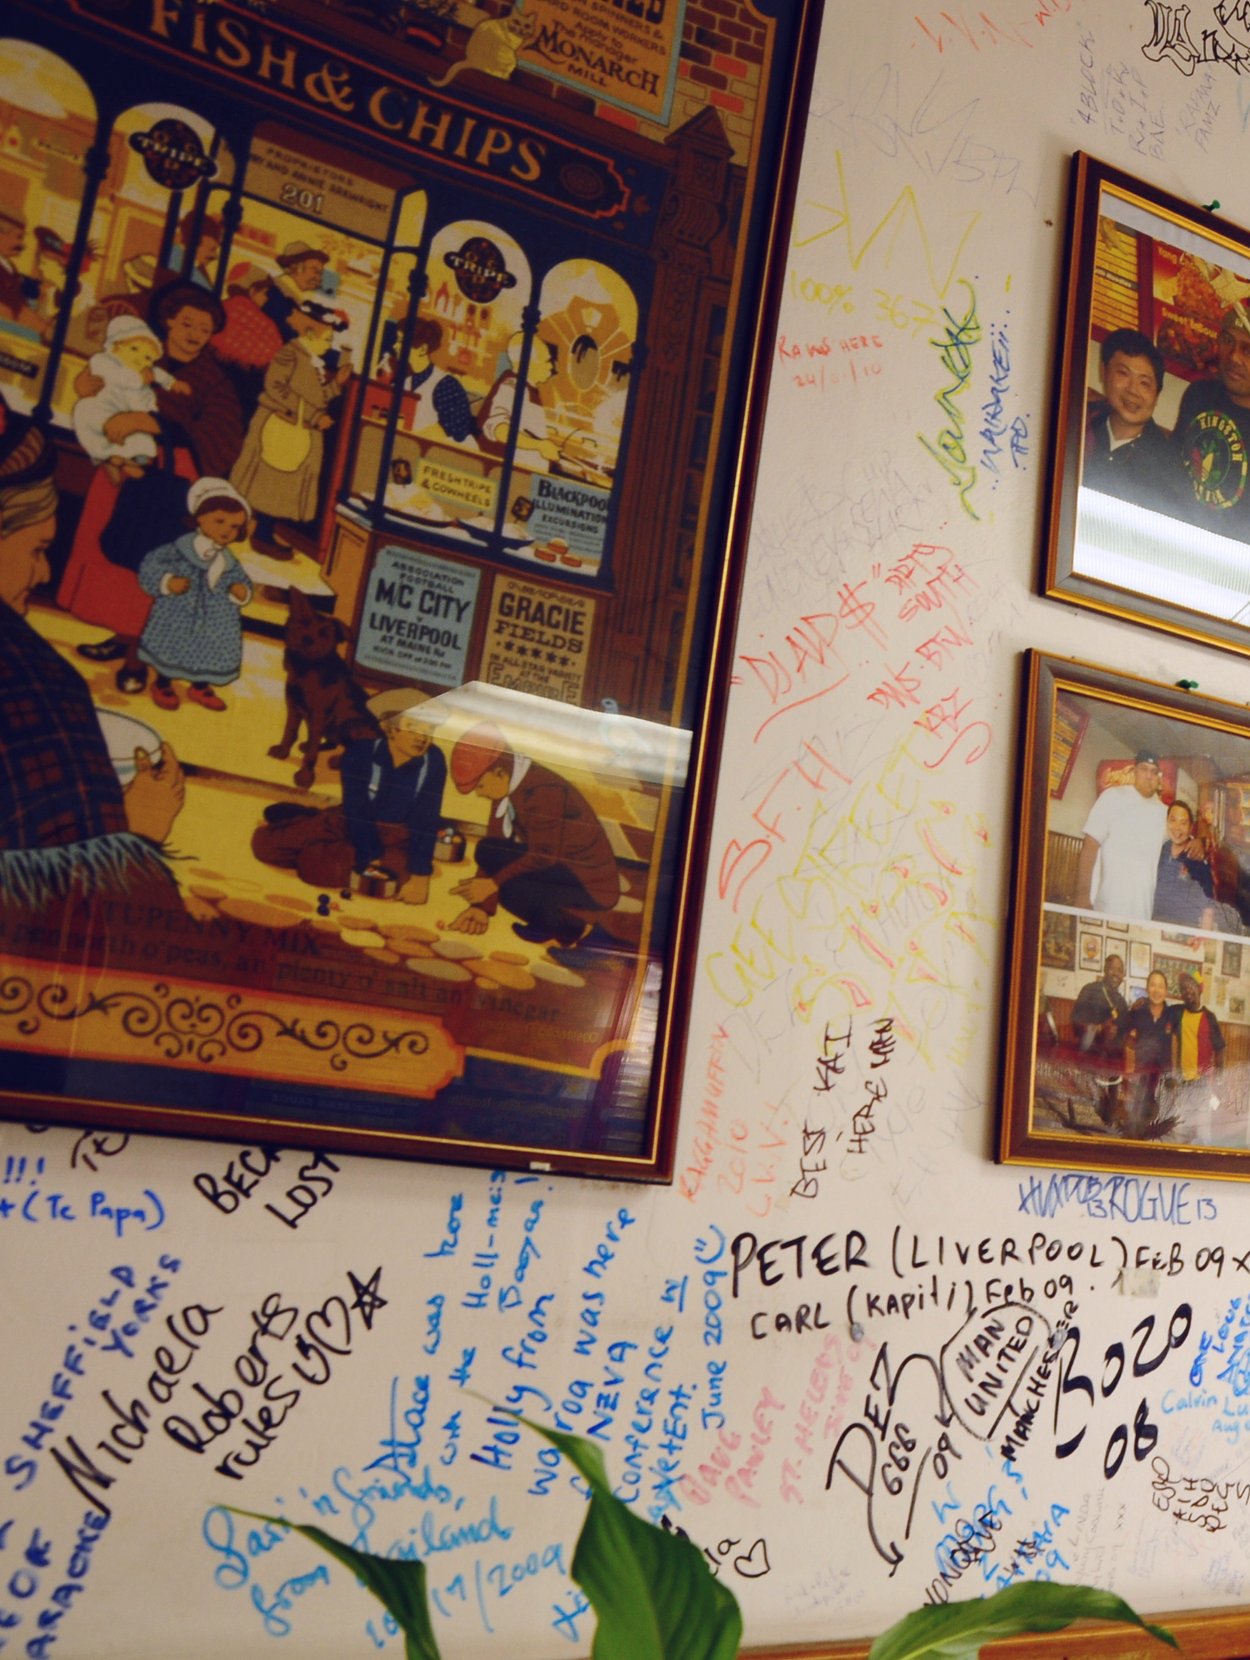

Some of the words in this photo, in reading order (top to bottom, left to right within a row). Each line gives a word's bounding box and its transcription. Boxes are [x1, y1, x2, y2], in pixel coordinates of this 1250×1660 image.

[573, 7, 609, 30] ROOM
[613, 25, 666, 56] WORKERS
[523, 25, 660, 96] MONARCH
[568, 64, 607, 86] MILL
[149, 0, 297, 89] FISH
[305, 61, 354, 113] &
[368, 85, 547, 182] CHIPS
[280, 182, 324, 215] 201
[446, 253, 511, 286] TRIPE
[1198, 418, 1244, 464] KINGSTON
[421, 480, 431, 490] &
[433, 484, 490, 507] COWHEELS
[423, 466, 462, 484] FRESH
[542, 514, 598, 534] EXCURSIONS
[391, 561, 464, 585] ASSOCIATION
[400, 574, 455, 593] FOOTBALL
[419, 590, 471, 623] CITY
[499, 592, 586, 635] GRACIE
[369, 612, 462, 651] LIVERPOOL
[380, 635, 394, 644] AT
[494, 619, 583, 654] FIELDS
[582, 1206, 636, 1278] here
[730, 1230, 869, 1299] PETER
[1195, 1243, 1229, 1274] 09
[574, 1289, 607, 1356] was
[702, 1270, 728, 1347] 2009
[751, 1299, 831, 1340] CARL
[1045, 1276, 1075, 1301] 09
[501, 1292, 554, 1369] from
[955, 1319, 1007, 1383] MAN
[964, 1316, 1034, 1416] UNITED
[701, 1360, 727, 1430] June
[1160, 1389, 1218, 1414] Calvin
